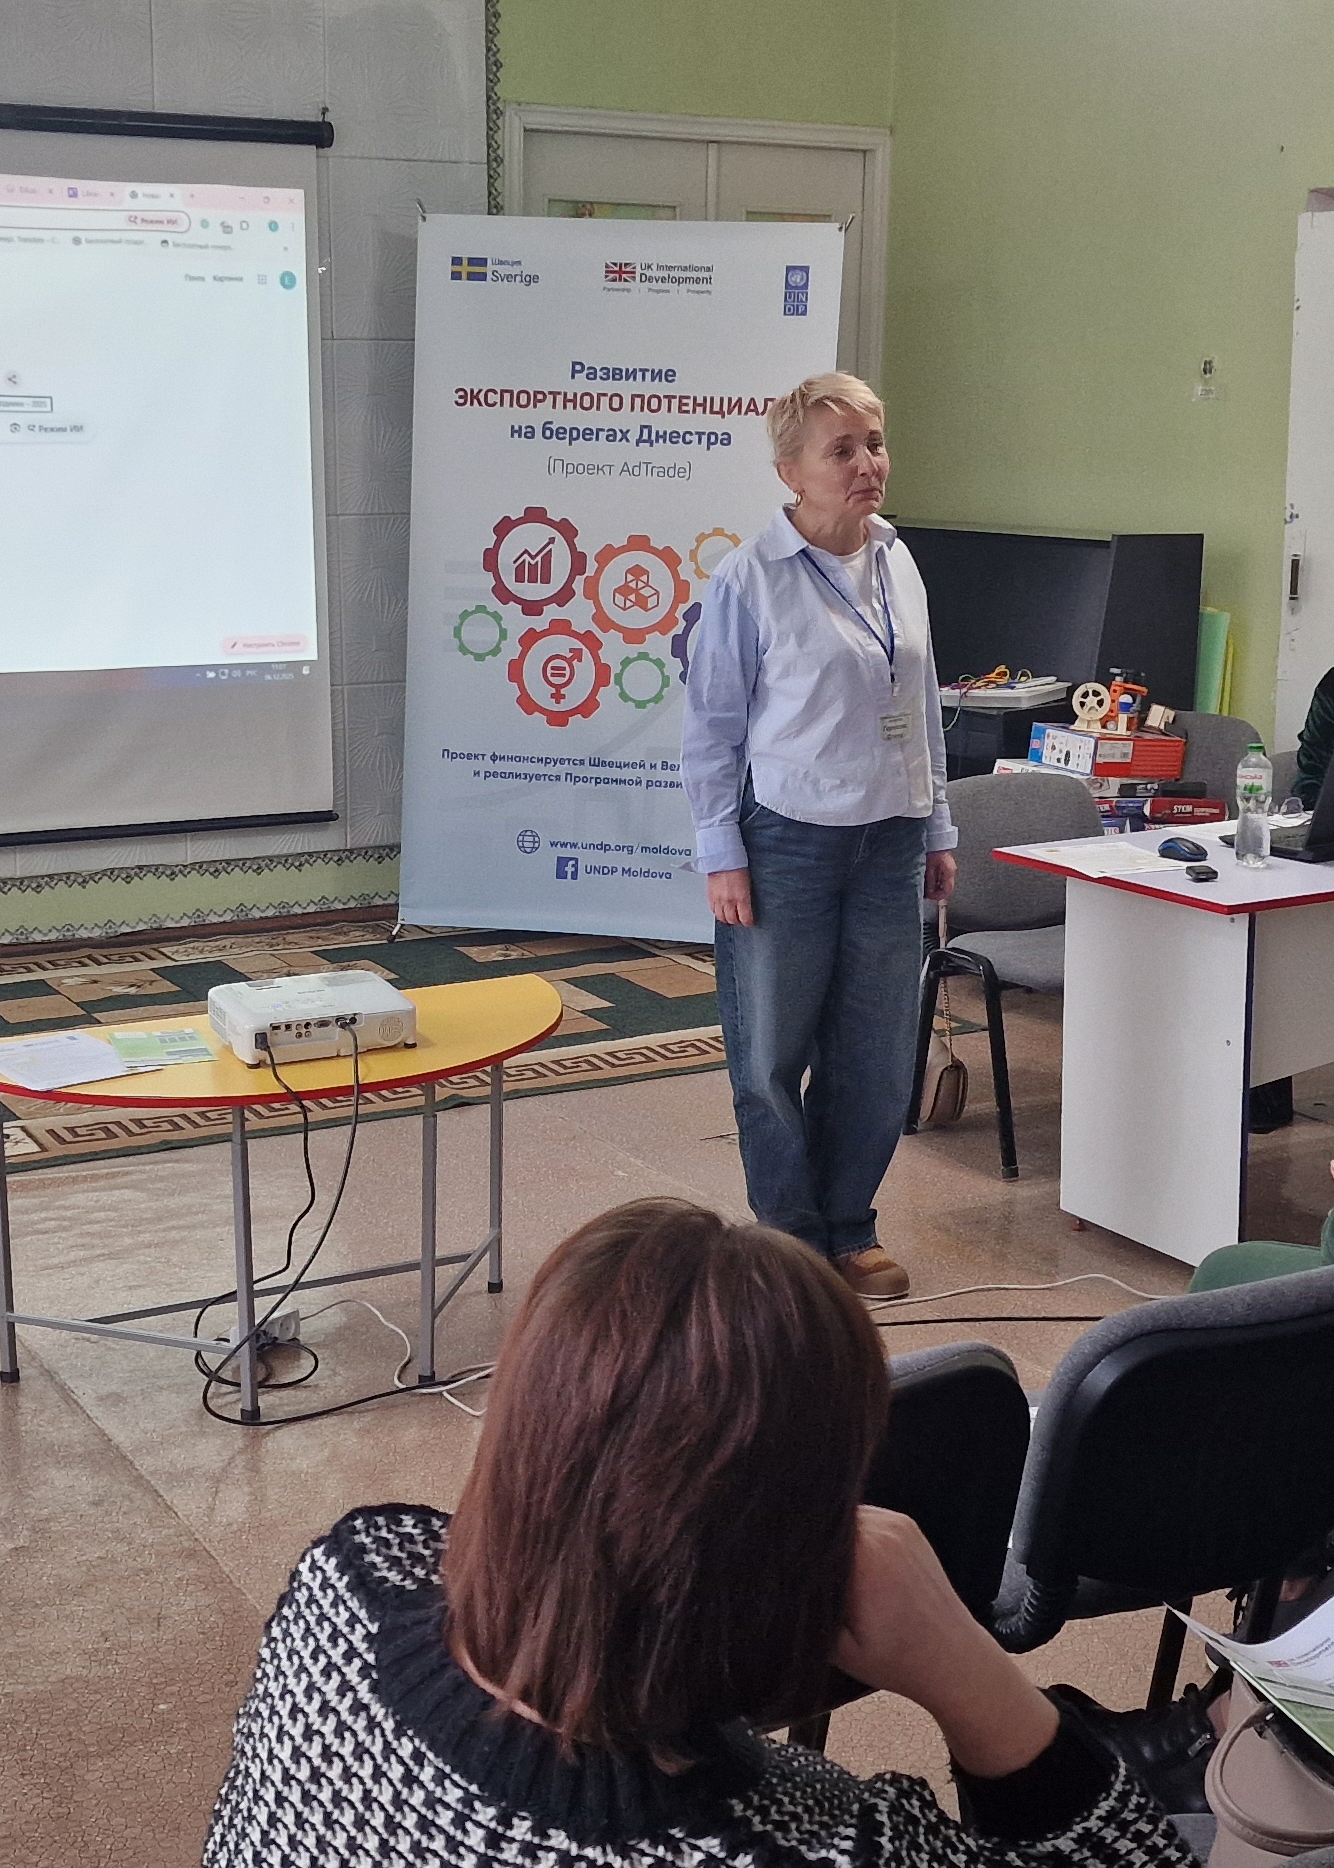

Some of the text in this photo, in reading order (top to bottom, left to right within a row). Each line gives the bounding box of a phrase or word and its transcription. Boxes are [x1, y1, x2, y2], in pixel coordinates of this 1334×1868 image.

[640, 262, 714, 273] UK International
[491, 269, 540, 287] Sverige
[639, 272, 713, 286] Development
[571, 361, 677, 384] Развитие
[454, 387, 775, 420] ЭКСПОРТНОГО ПОТЕНЦИАЛ
[510, 421, 731, 451] на берегах Днестра
[547, 455, 692, 481] (Проект AdTrade)
[441, 748, 680, 772] Проект финансируется Швецией и Вел
[483, 770, 561, 783] реализуется
[564, 772, 643, 787] Программой
[645, 779, 683, 790] разви
[549, 840, 692, 857] www.undp.org/moldova
[585, 864, 672, 880] UNDP Moldova
